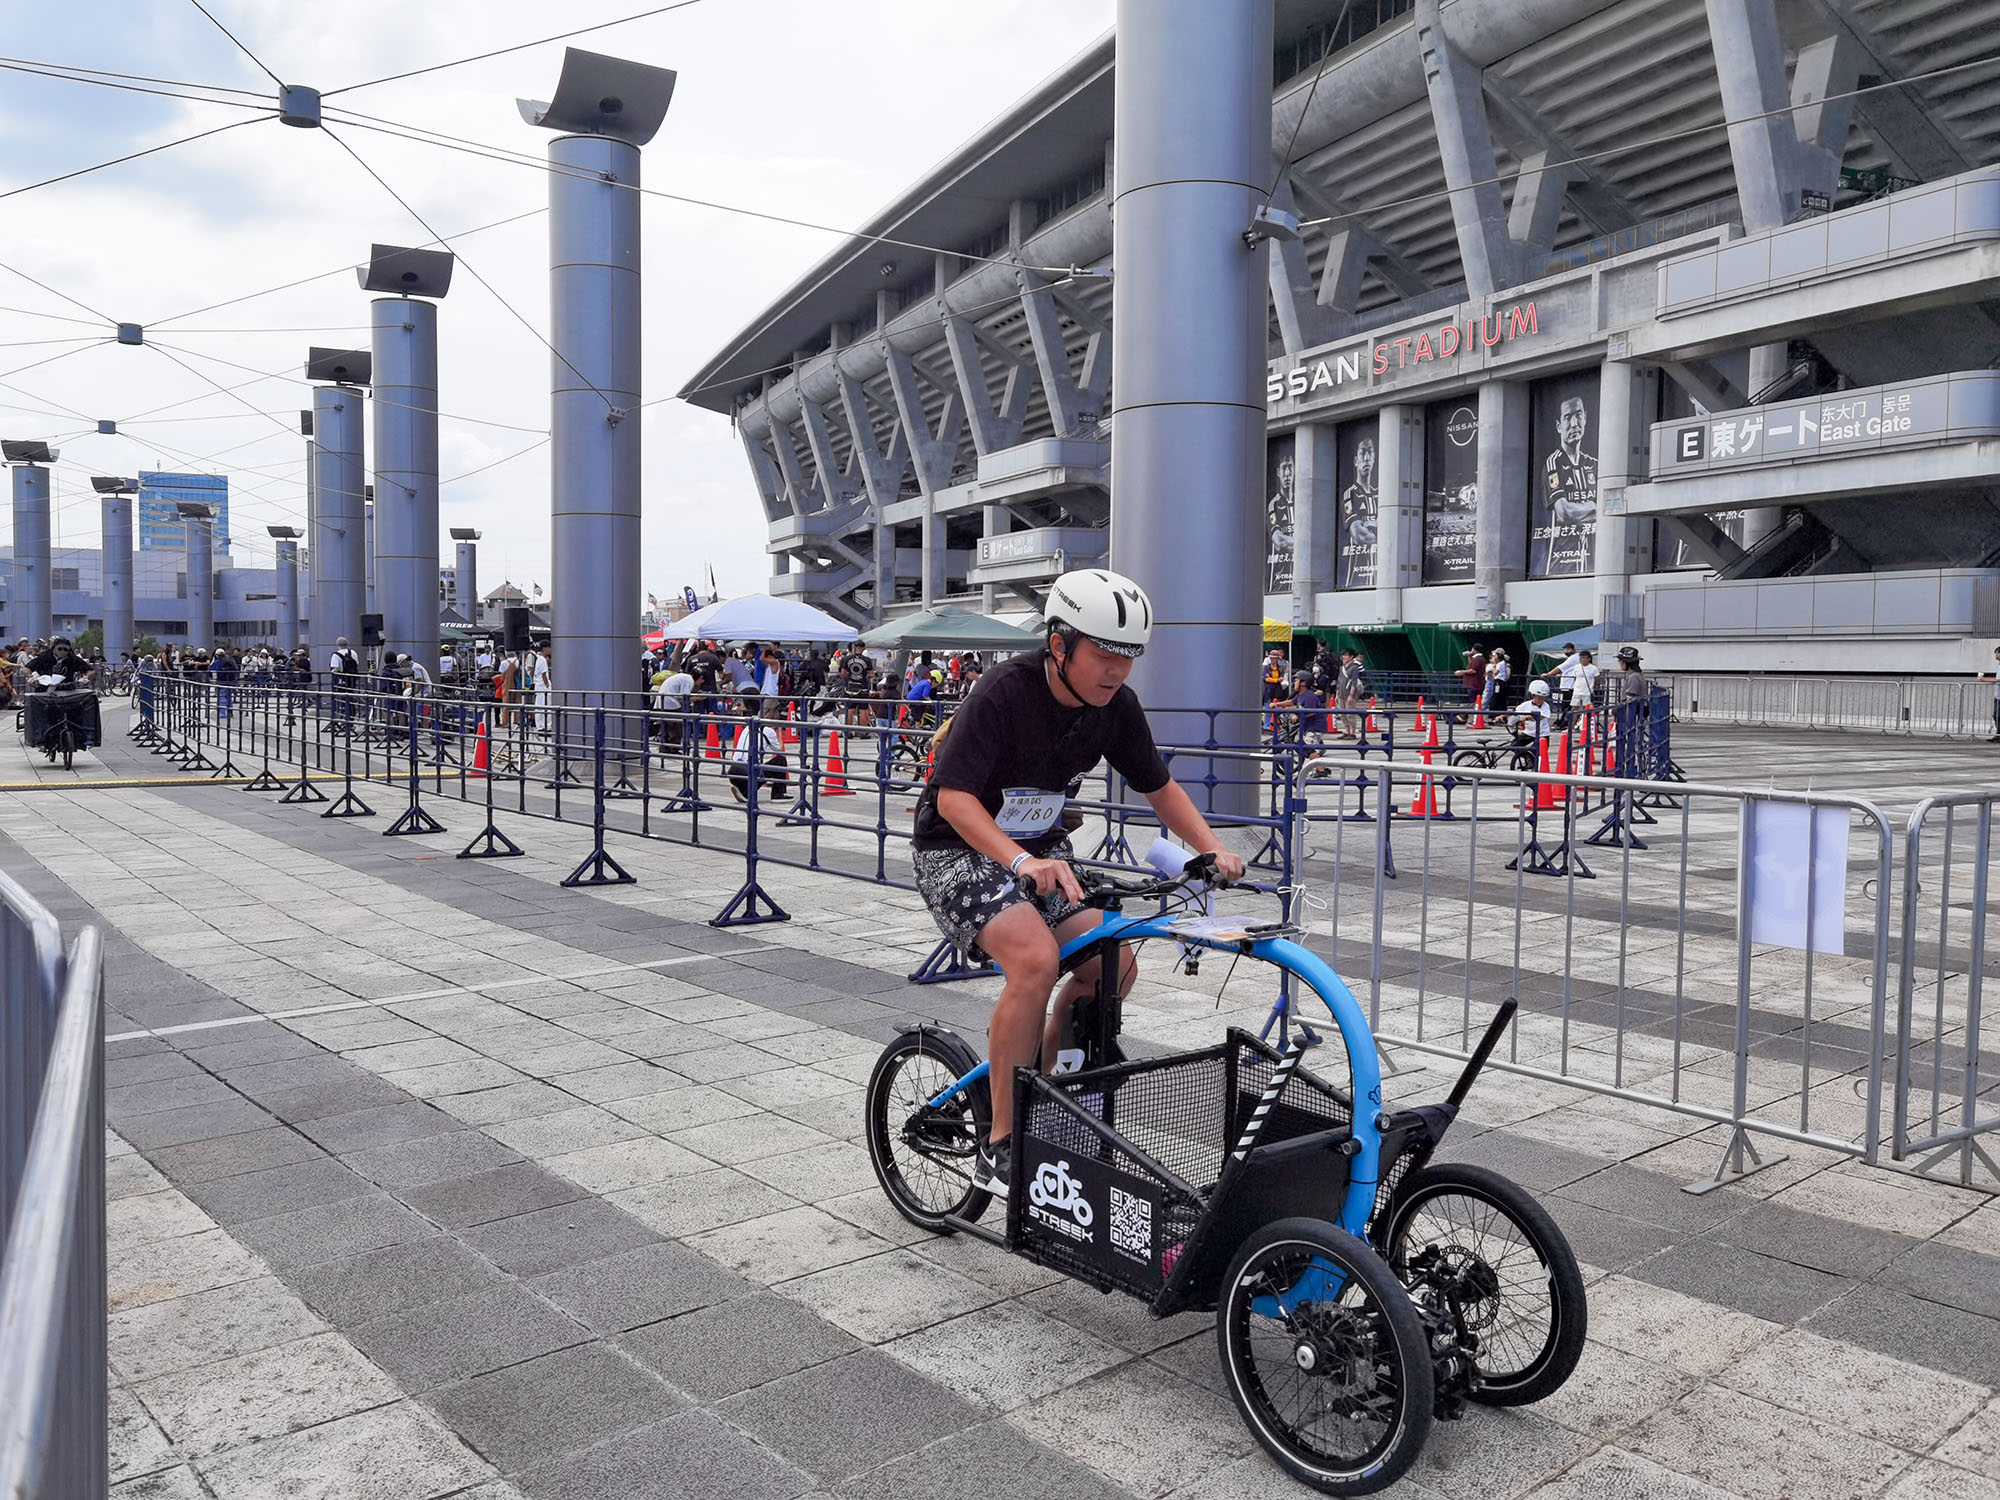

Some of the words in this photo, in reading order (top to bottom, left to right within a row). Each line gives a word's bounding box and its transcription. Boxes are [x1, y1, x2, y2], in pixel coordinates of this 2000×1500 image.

[1373, 302, 1539, 375] STADIUM
[1821, 401, 1867, 424] 东大门
[1881, 393, 1912, 414] 동문
[1446, 421, 1479, 433] NISSAN
[1711, 410, 1818, 459] 東ゲート
[1820, 421, 1861, 443] East
[1866, 415, 1912, 436] Gate
[1682, 431, 1700, 457] E
[1443, 557, 1476, 566] X-TRAIL
[1021, 807, 1053, 823] 180
[1028, 1205, 1094, 1244] STREEK
